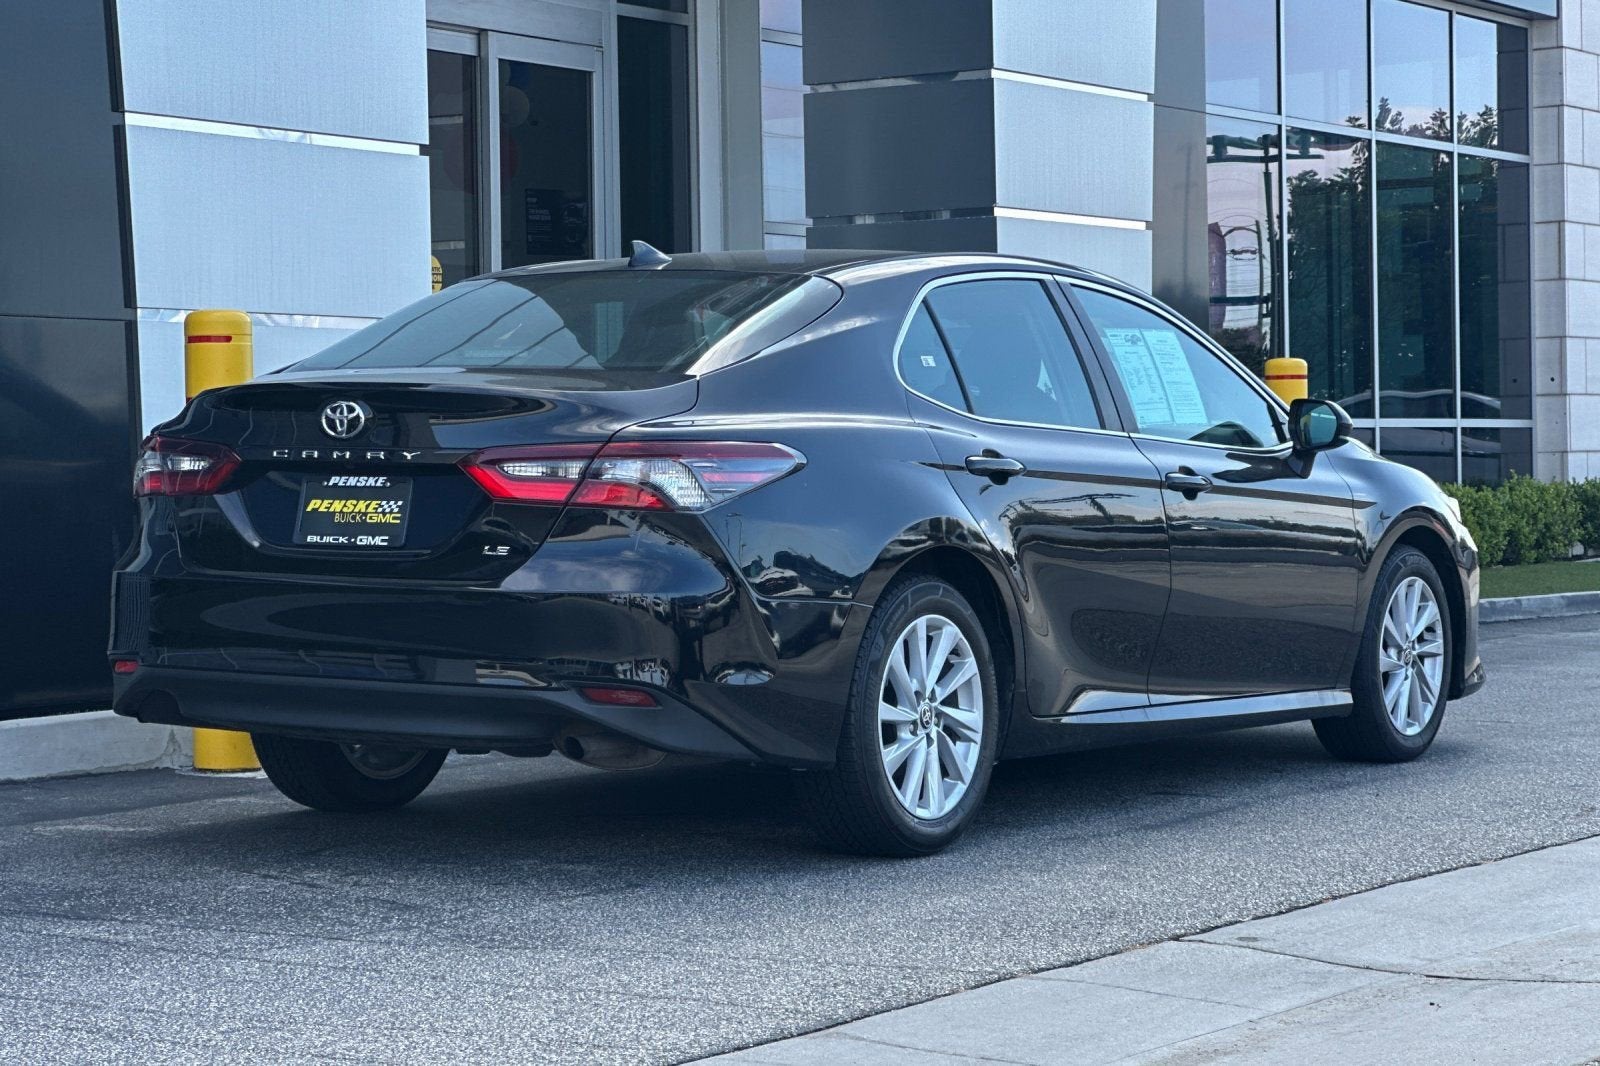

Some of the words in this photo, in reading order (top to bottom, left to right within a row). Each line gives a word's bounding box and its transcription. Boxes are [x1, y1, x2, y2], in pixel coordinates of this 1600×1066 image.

[272, 449, 421, 460] CAMRY
[328, 476, 387, 487] PENSKE
[306, 499, 380, 512] PENSKE
[334, 513, 361, 523] BUICK
[366, 513, 402, 524] GMC
[307, 535, 349, 543] BUICK
[356, 535, 390, 546] GMC
